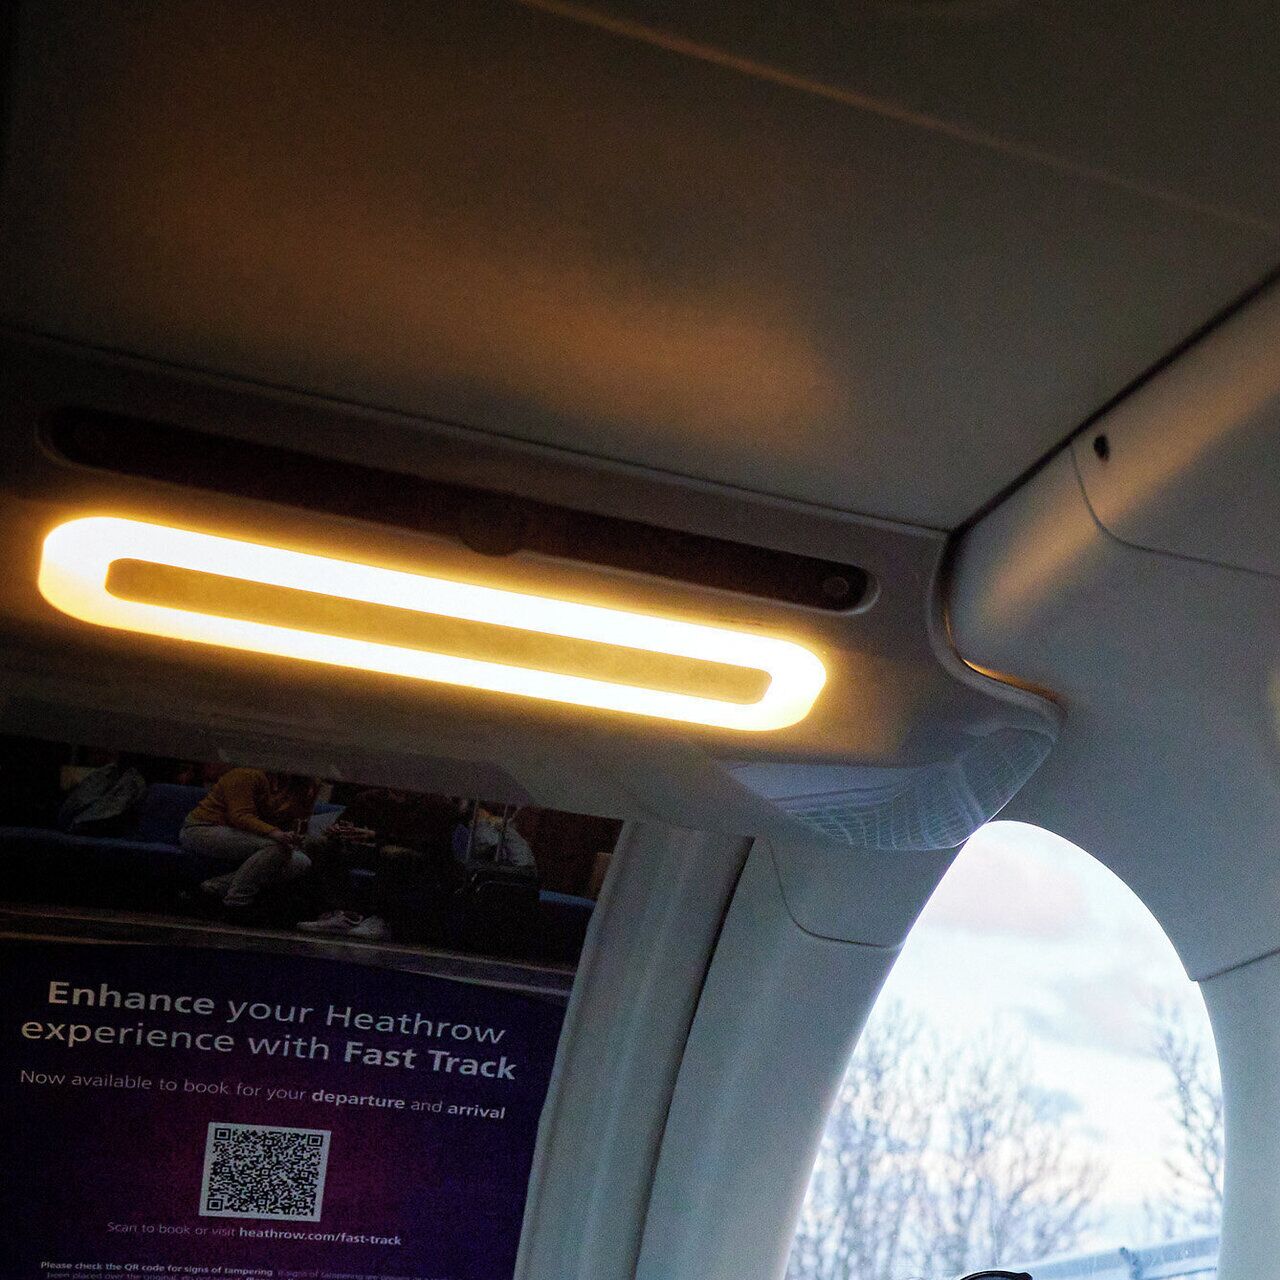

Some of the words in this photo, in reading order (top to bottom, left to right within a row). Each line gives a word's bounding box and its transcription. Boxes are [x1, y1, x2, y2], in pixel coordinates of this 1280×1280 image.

[48, 980, 215, 1015] Enhance
[226, 1000, 314, 1024] your
[326, 1004, 506, 1044] Heathrow
[21, 1020, 235, 1052] experience
[248, 1034, 330, 1060] with
[343, 1040, 418, 1069] Fast
[427, 1049, 517, 1080] Track
[20, 1069, 66, 1085] Now
[71, 1073, 152, 1090] available
[159, 1078, 178, 1092] to
[184, 1079, 229, 1095] book
[236, 1083, 261, 1096] for
[266, 1087, 305, 1101] your
[311, 1089, 405, 1110] departure
[410, 1100, 443, 1113] and
[446, 1104, 506, 1120] arrival
[107, 1222, 137, 1233] Scan
[142, 1224, 155, 1234] to
[158, 1224, 191, 1235] book
[211, 1226, 235, 1237] visit
[239, 1226, 402, 1246] heathrow.com/fast-track
[41, 1261, 73, 1270] Please
[74, 1262, 102, 1270] check
[105, 1263, 122, 1271] the
[124, 1263, 139, 1271] QR
[141, 1264, 165, 1272] code
[167, 1265, 182, 1273] for
[184, 1265, 209, 1275] signs
[211, 1267, 222, 1275] of
[224, 1267, 273, 1277] tampering
